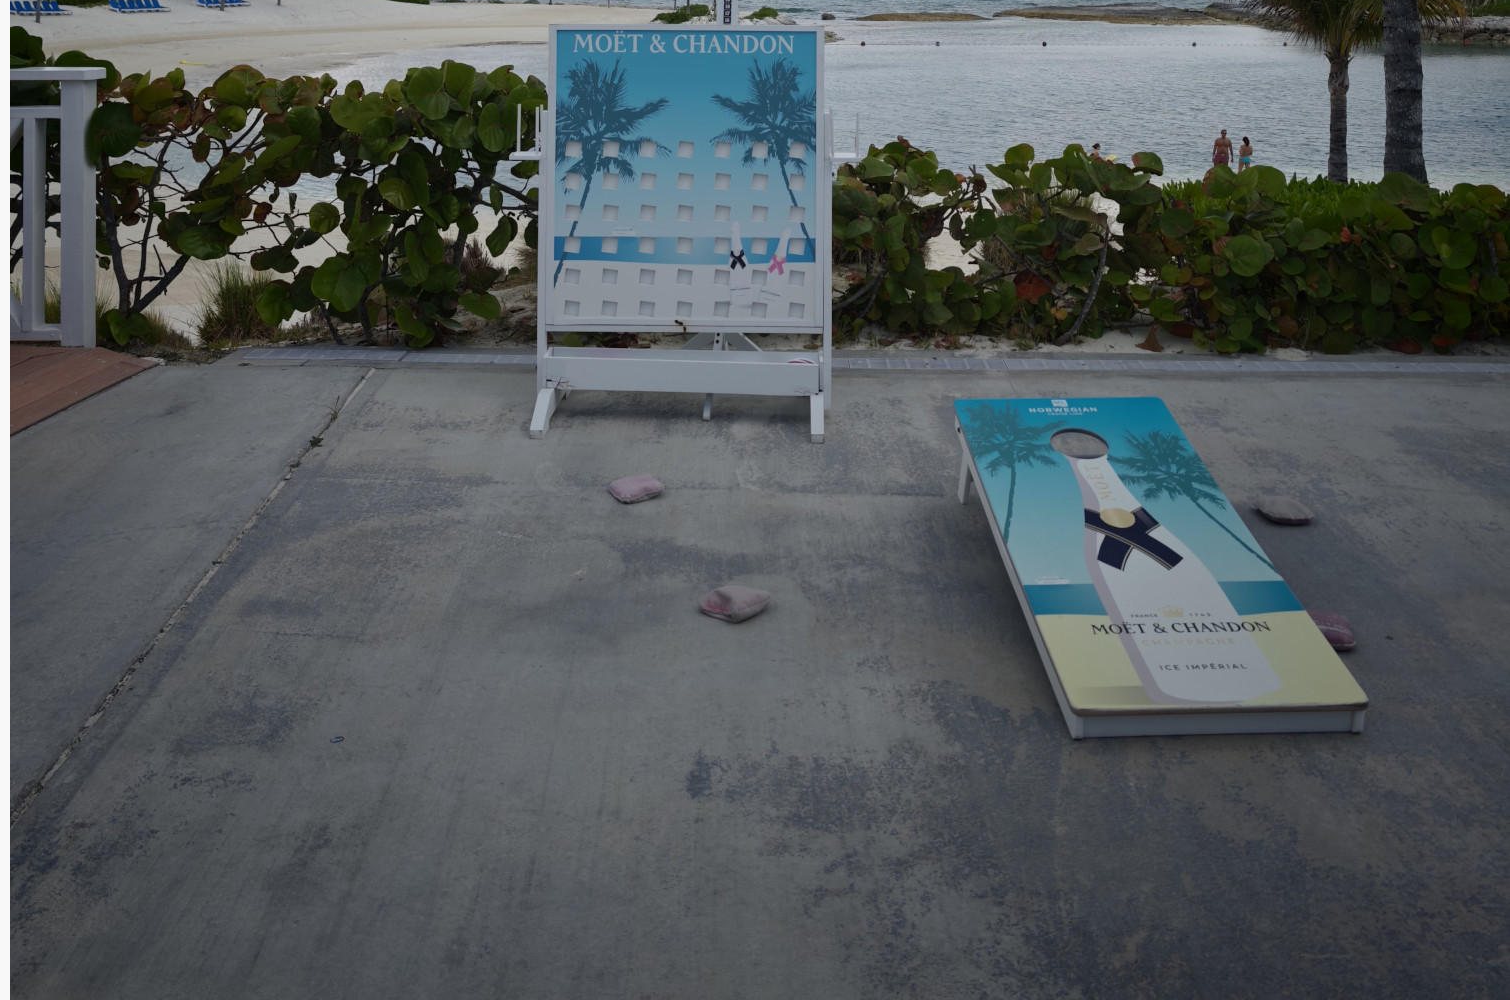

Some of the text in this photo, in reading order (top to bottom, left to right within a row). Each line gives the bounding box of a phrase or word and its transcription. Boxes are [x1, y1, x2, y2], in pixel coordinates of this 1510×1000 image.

[573, 30, 795, 54] MOËT & CHANDON
[1091, 621, 1271, 635] MOËT & CHANDON
[1142, 637, 1237, 647] CHAMPAGNE
[1186, 662, 1248, 670] IMPÉRIAL
